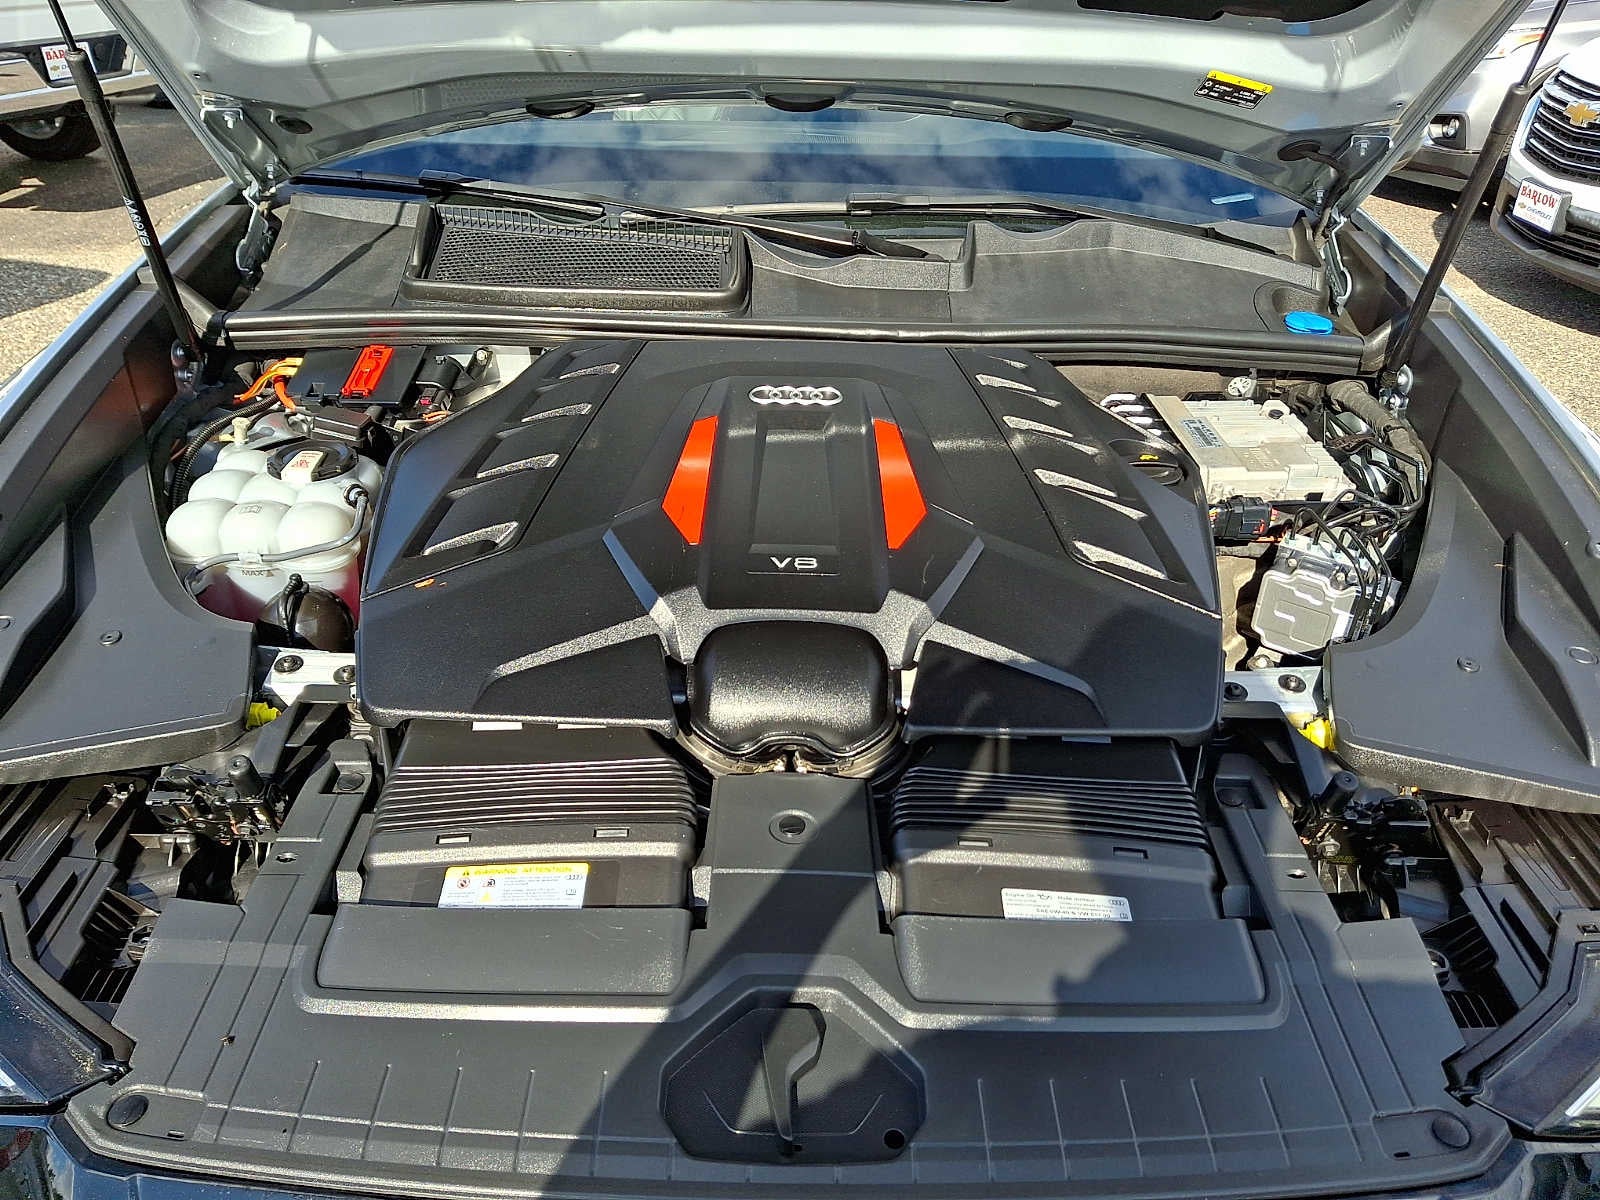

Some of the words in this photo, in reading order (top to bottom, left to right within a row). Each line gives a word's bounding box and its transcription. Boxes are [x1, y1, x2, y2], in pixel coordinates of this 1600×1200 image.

[1521, 186, 1557, 208] BARLOW
[1526, 206, 1552, 220] CHEVROLET
[770, 556, 818, 569] V8
